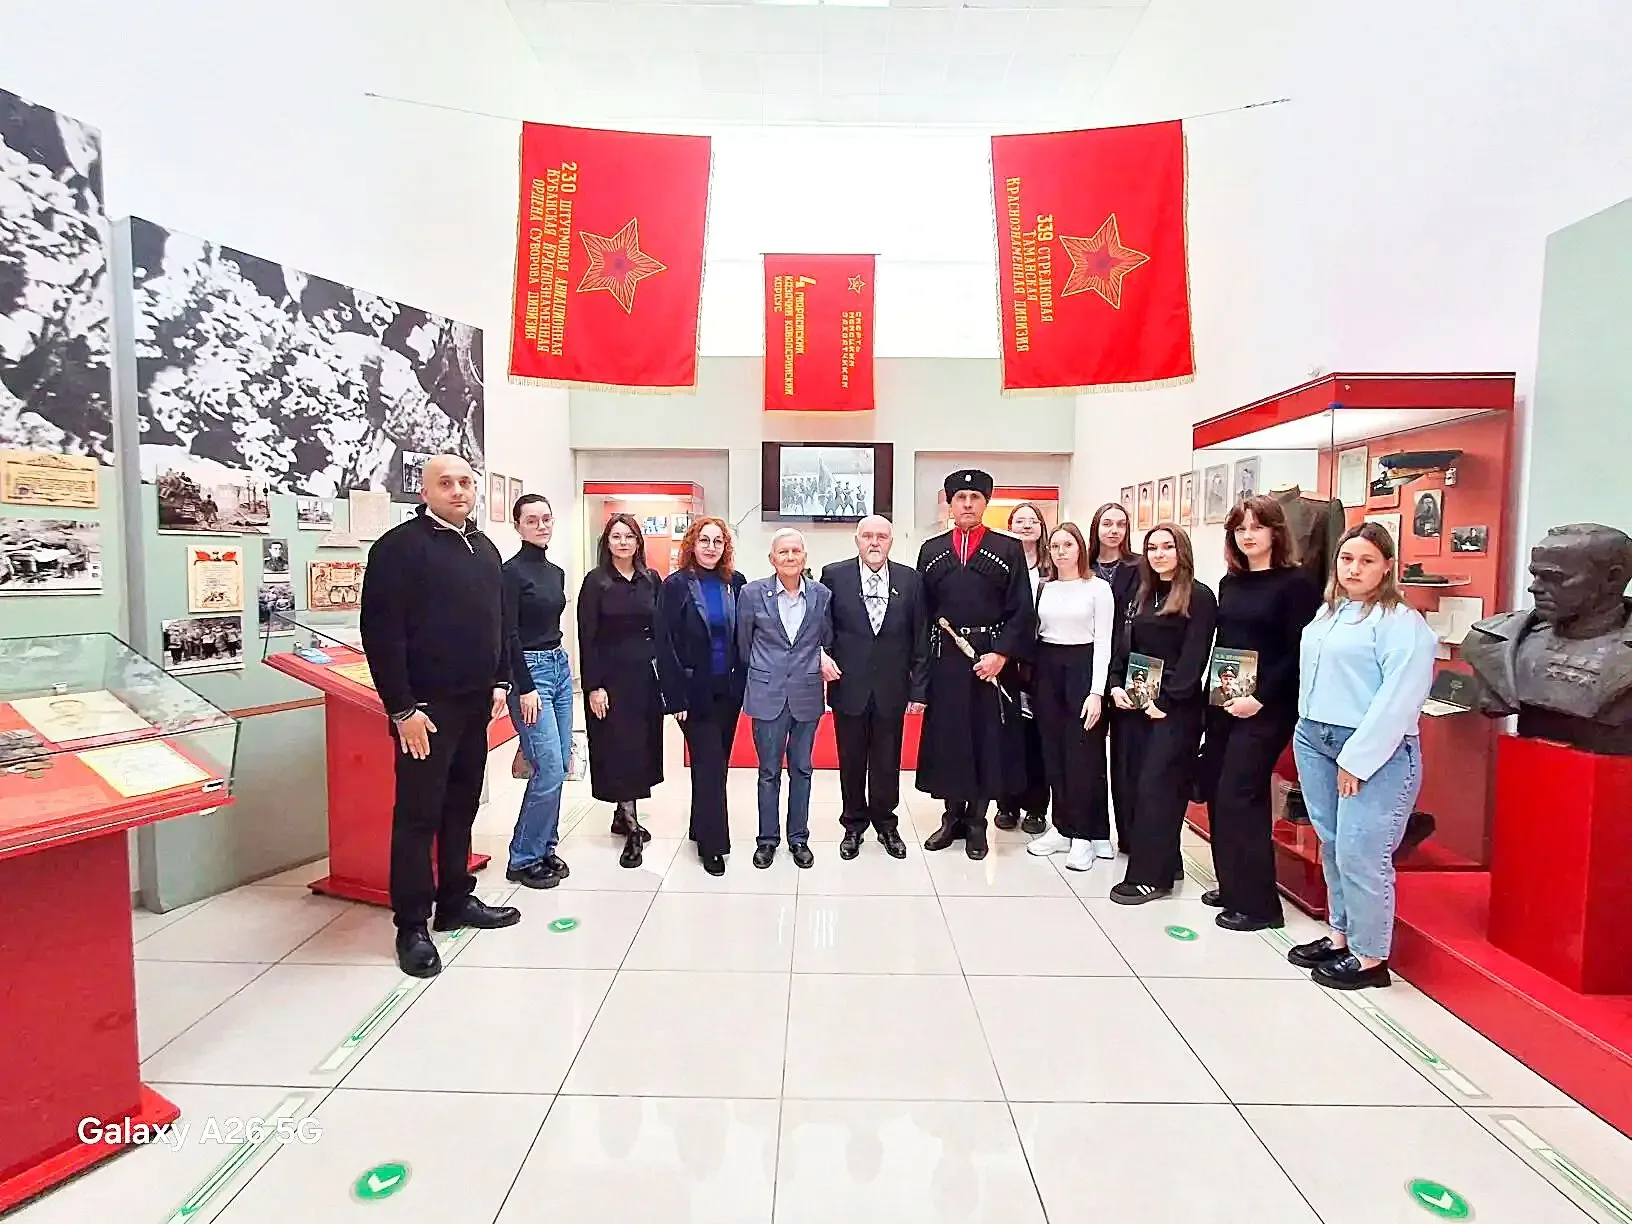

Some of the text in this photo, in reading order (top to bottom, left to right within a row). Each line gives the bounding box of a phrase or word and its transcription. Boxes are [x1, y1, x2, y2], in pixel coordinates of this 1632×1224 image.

[525, 178, 545, 340] ОРДЕНА СУВОРОВА ДИВИЗИЯ
[537, 168, 560, 352] КУБАНСКАЯ КРАСНОЗНАМЕННАЯ
[551, 161, 577, 356] 230 ШТУРМОВАЯ АВИАЦИОННАЯ
[774, 276, 782, 312] КОРПУС
[796, 275, 816, 288] 4
[1006, 177, 1029, 352] КРАСНОЗНАМЕННАЯ ДИВИЗИЯ
[1022, 229, 1038, 301] ТАМАНСКАЯ
[1037, 214, 1053, 322] 339 СТРЕЛКОВАЯ
